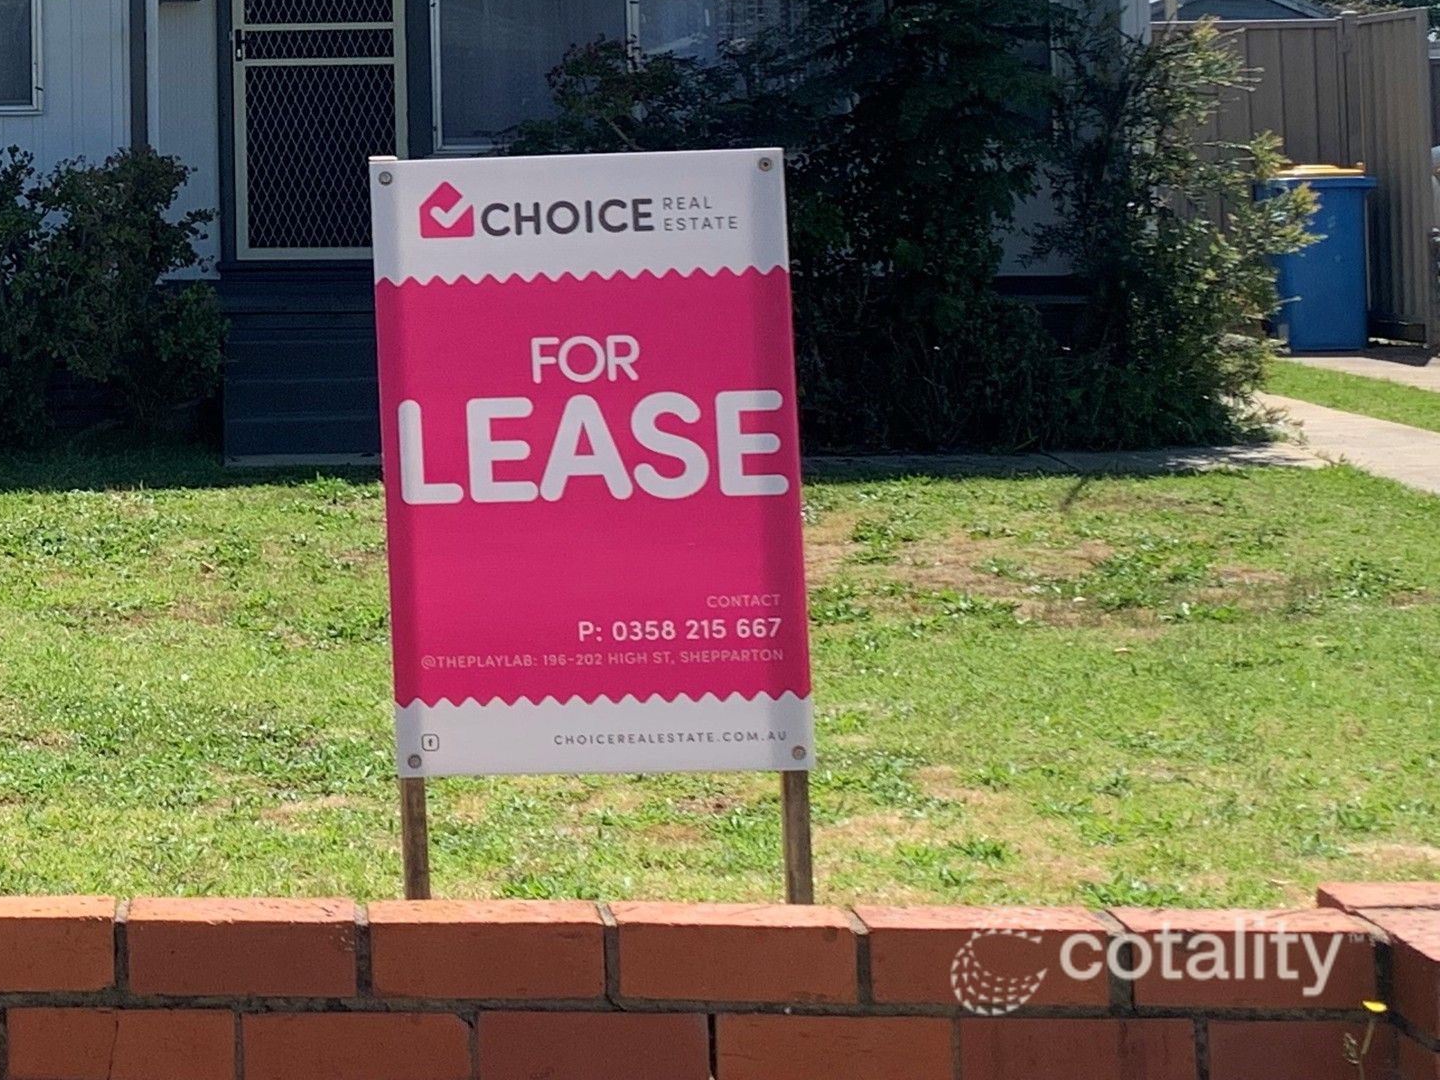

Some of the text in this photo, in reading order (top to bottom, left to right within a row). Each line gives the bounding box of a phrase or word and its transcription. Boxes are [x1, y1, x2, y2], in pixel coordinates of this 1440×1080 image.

[662, 196, 713, 211] REAL
[480, 198, 656, 237] CHOICE
[663, 215, 739, 232] ESTATE
[531, 335, 640, 384] FOR
[397, 390, 789, 505] LEASE
[706, 593, 781, 608] CONTACT
[578, 618, 782, 642] P: 0358 215 667
[420, 654, 537, 670] @THEPLAYLAB:
[543, 653, 603, 667] 196-202
[607, 651, 648, 665] HIGH
[680, 648, 783, 663] SHEPPARTON
[553, 731, 788, 746] CHOICEREALESTATE.COM.AU
